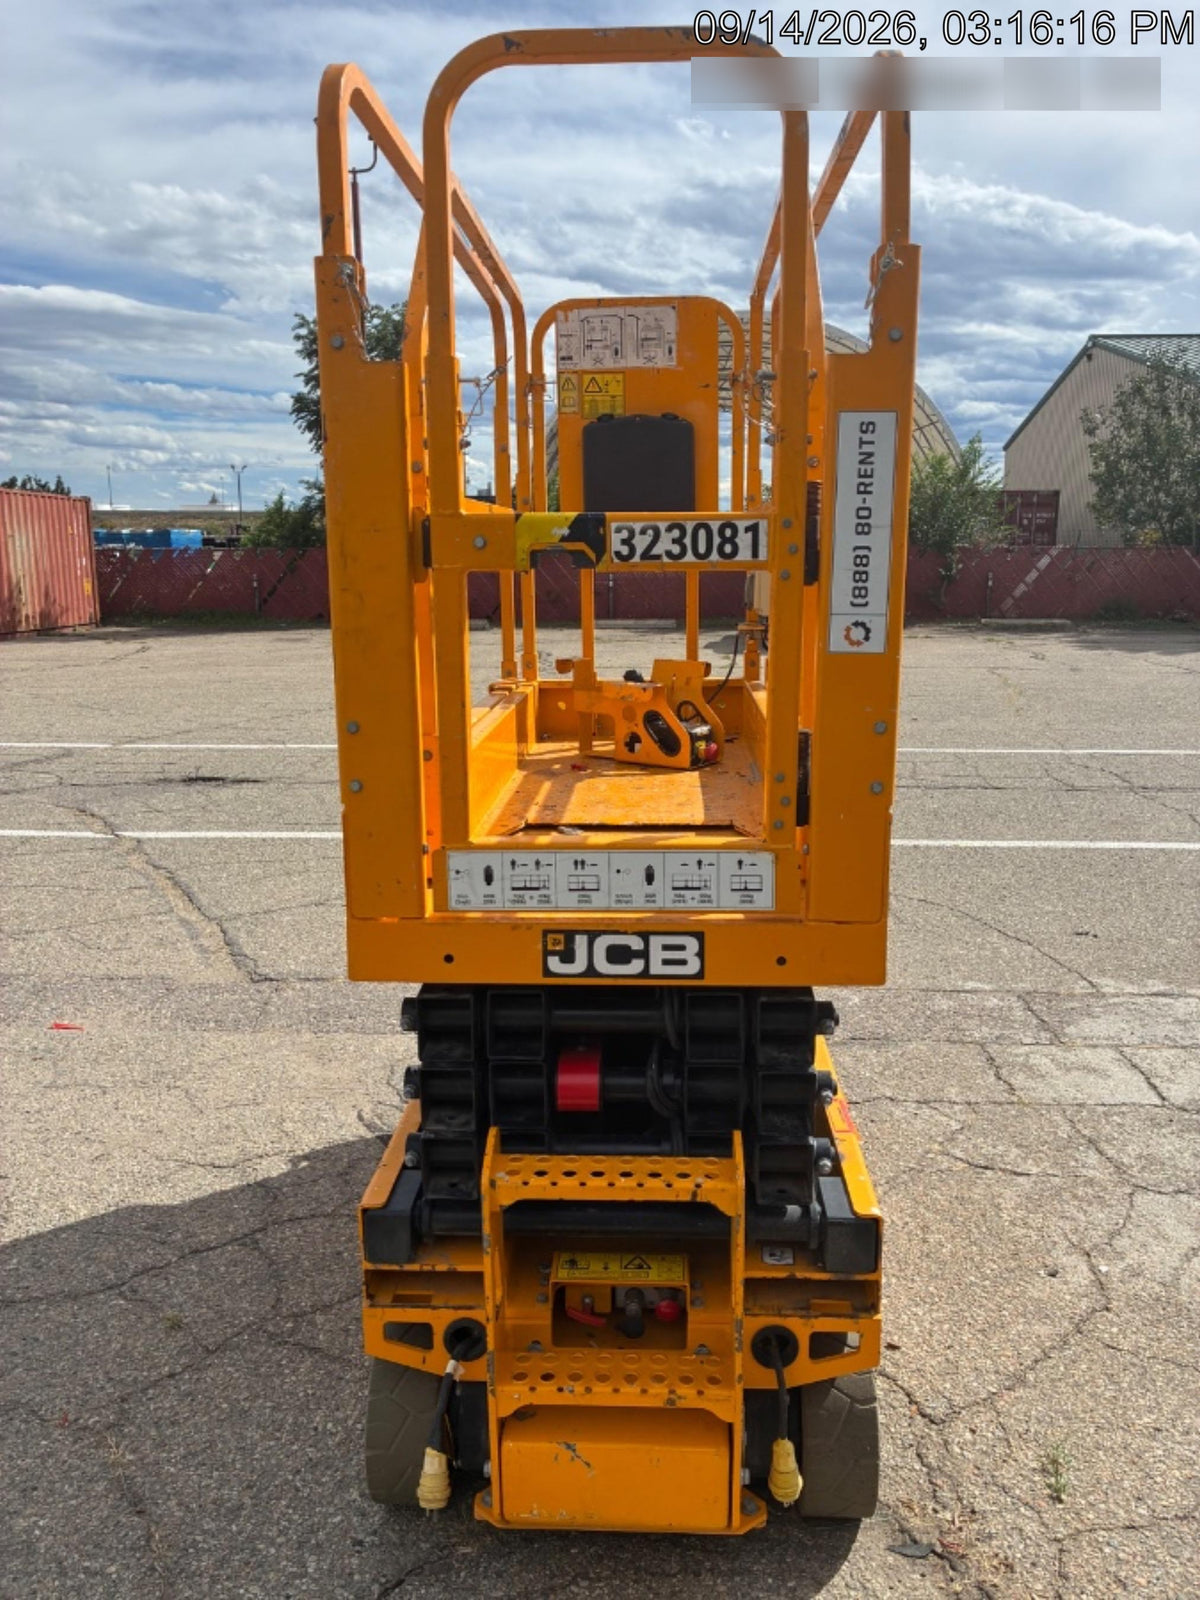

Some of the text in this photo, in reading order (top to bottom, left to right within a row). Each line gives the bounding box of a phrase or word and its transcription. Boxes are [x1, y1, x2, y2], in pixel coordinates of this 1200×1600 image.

[850, 420, 877, 608] (888) 80-RENTS
[613, 521, 760, 562] 323081
[547, 934, 701, 975] JCB
